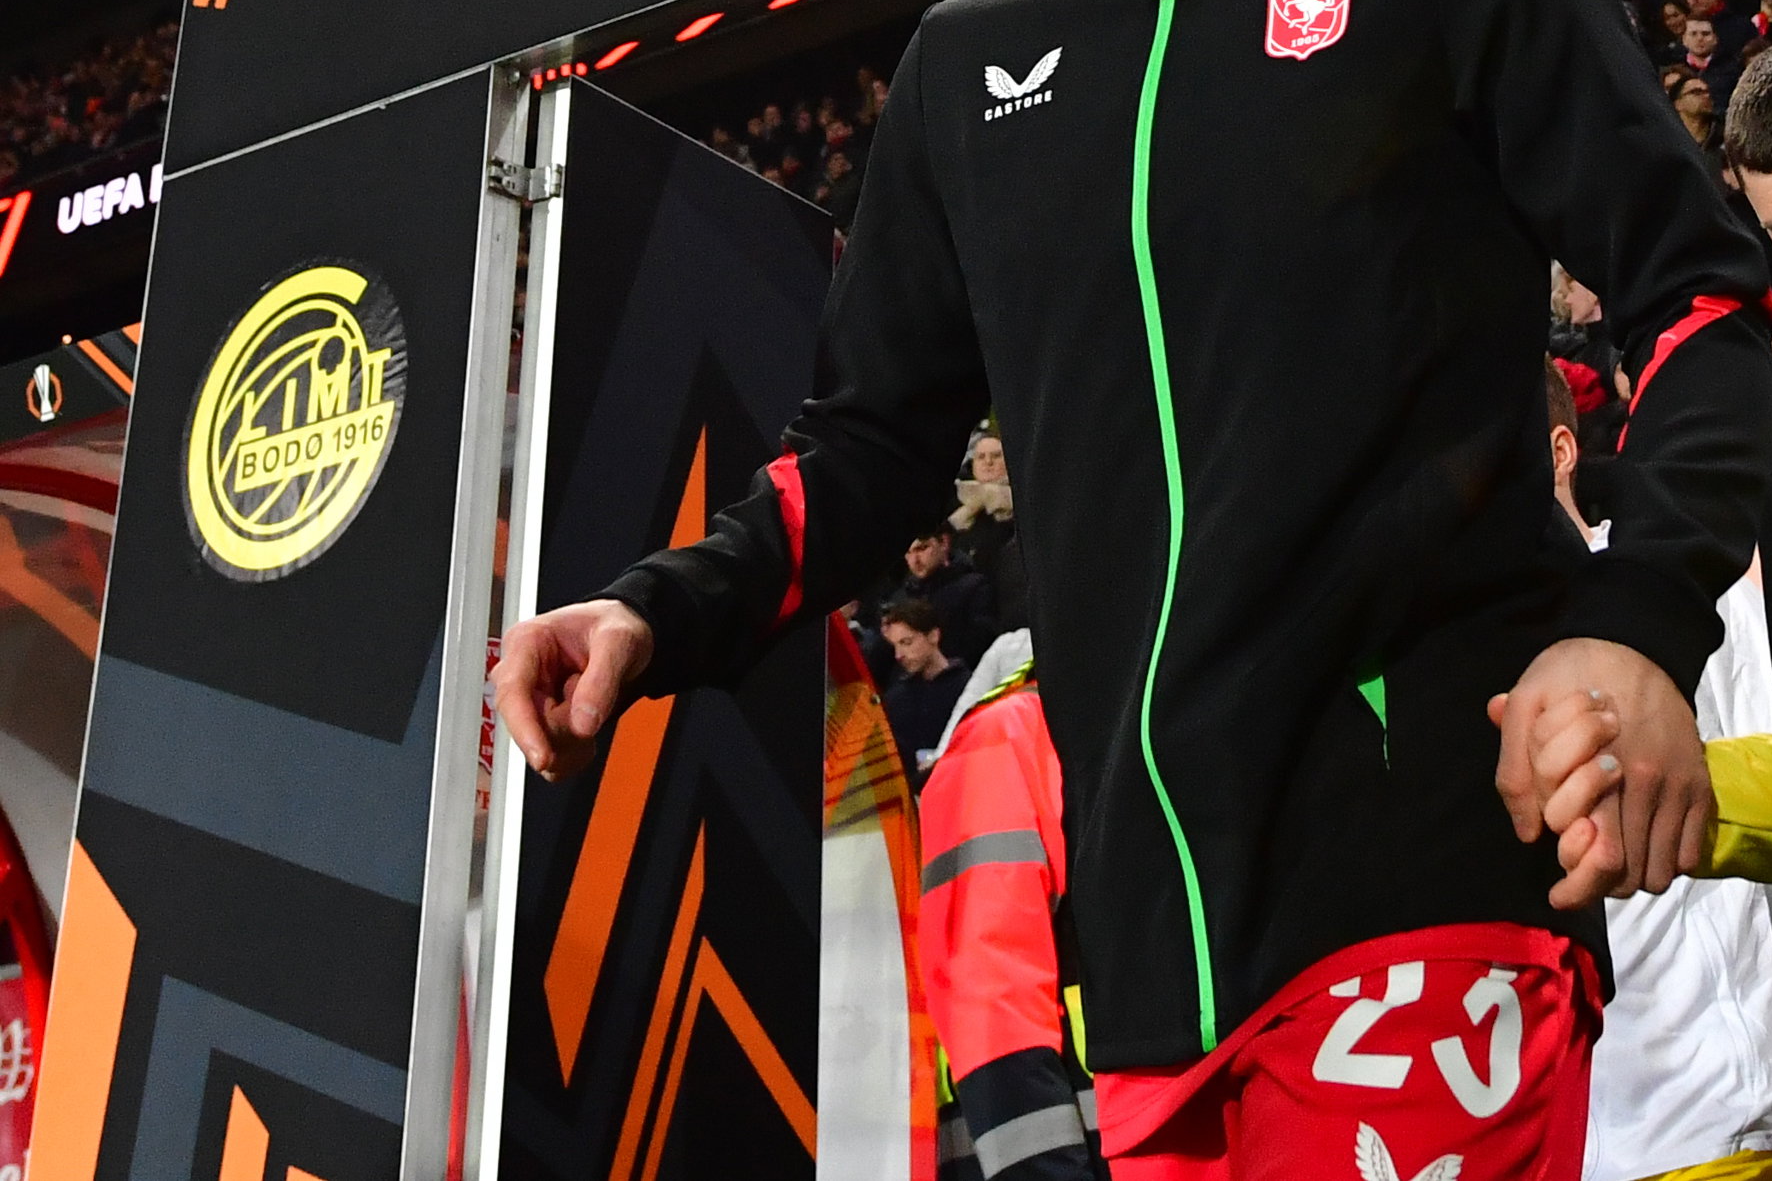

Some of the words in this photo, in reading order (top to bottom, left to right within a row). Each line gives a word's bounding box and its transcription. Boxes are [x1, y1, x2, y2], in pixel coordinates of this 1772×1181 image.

[1290, 33, 1320, 48] 1965
[984, 89, 1053, 122] CASTORE
[57, 172, 145, 234] UEFA
[332, 414, 385, 454] 1916
